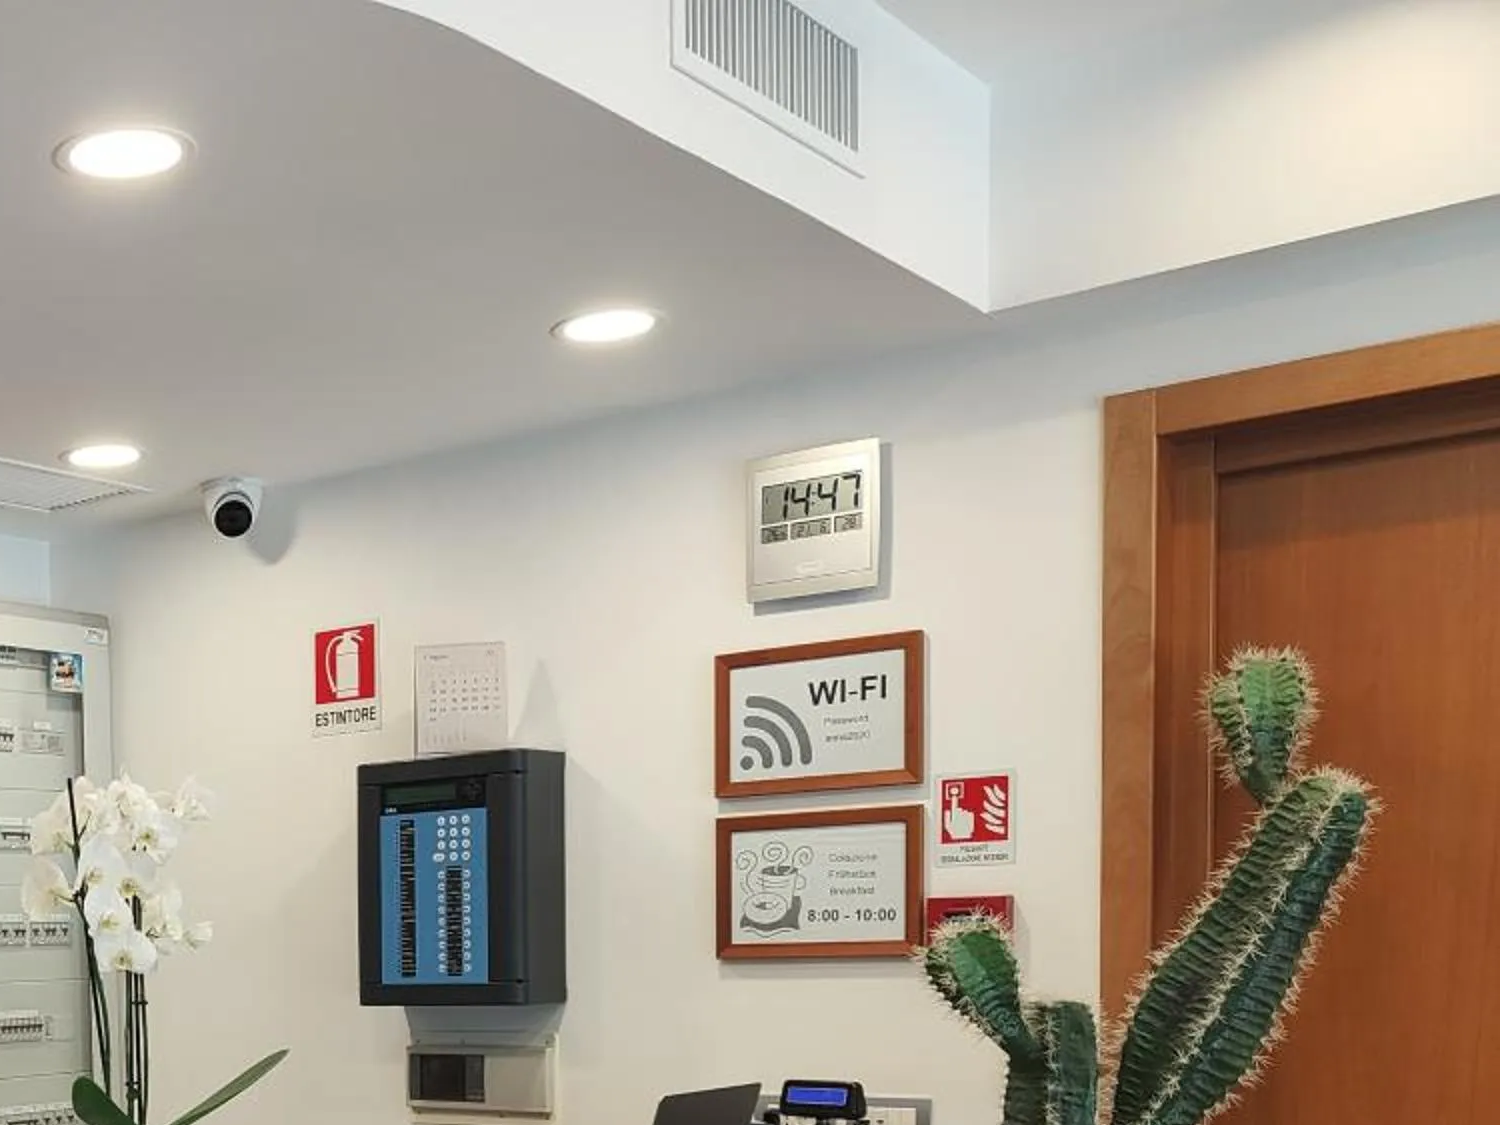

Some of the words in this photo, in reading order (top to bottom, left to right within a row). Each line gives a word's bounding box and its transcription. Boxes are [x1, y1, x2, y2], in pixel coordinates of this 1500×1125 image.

[783, 474, 861, 520] 14:47
[808, 674, 887, 706] WI-FI
[315, 705, 376, 727] ESTINTORE
[807, 908, 840, 922] 8:00
[855, 907, 897, 922] 10:00
